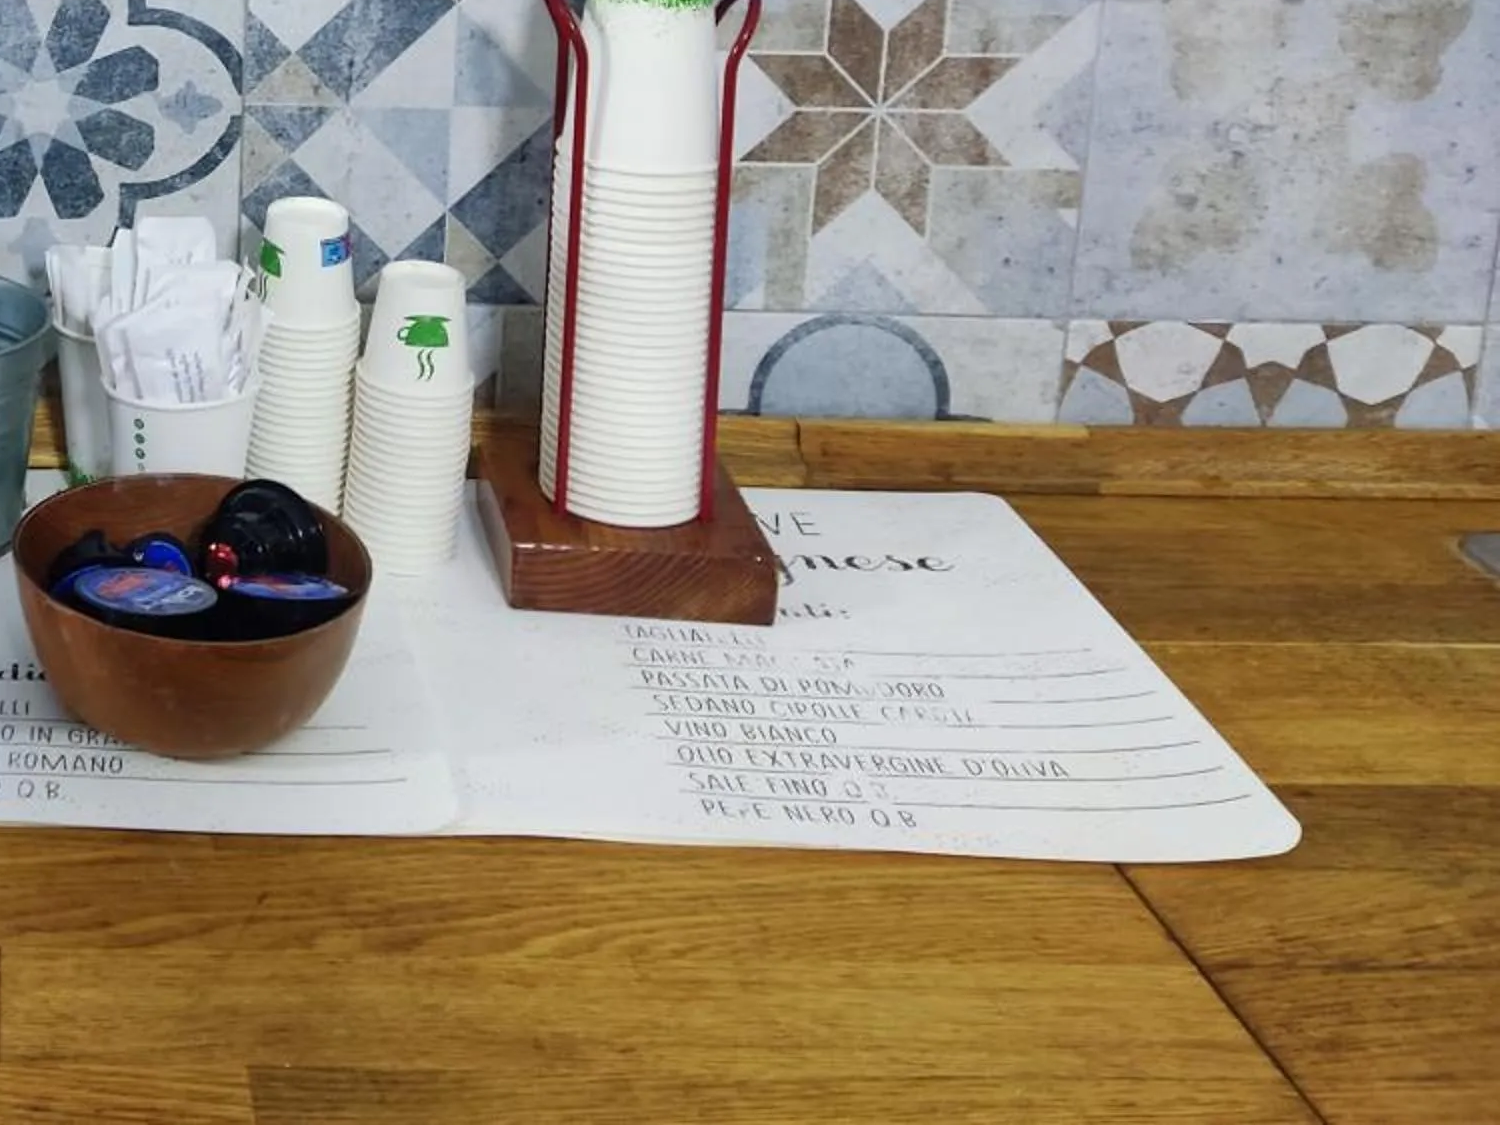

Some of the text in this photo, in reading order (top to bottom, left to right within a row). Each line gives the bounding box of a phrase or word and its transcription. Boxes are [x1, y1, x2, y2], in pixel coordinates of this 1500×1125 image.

[640, 669, 750, 691] PASSATA
[760, 677, 788, 692] DI
[652, 694, 755, 715] SEDANO
[29, 726, 53, 744] IN
[664, 720, 838, 744] VINO BIANCO
[8, 751, 123, 774] ROMANO
[676, 745, 733, 765] OLIO
[745, 749, 952, 776] EXTRAVERGINE
[688, 771, 749, 793] SALE
[766, 776, 828, 797] FINO
[782, 804, 856, 825] NERO
